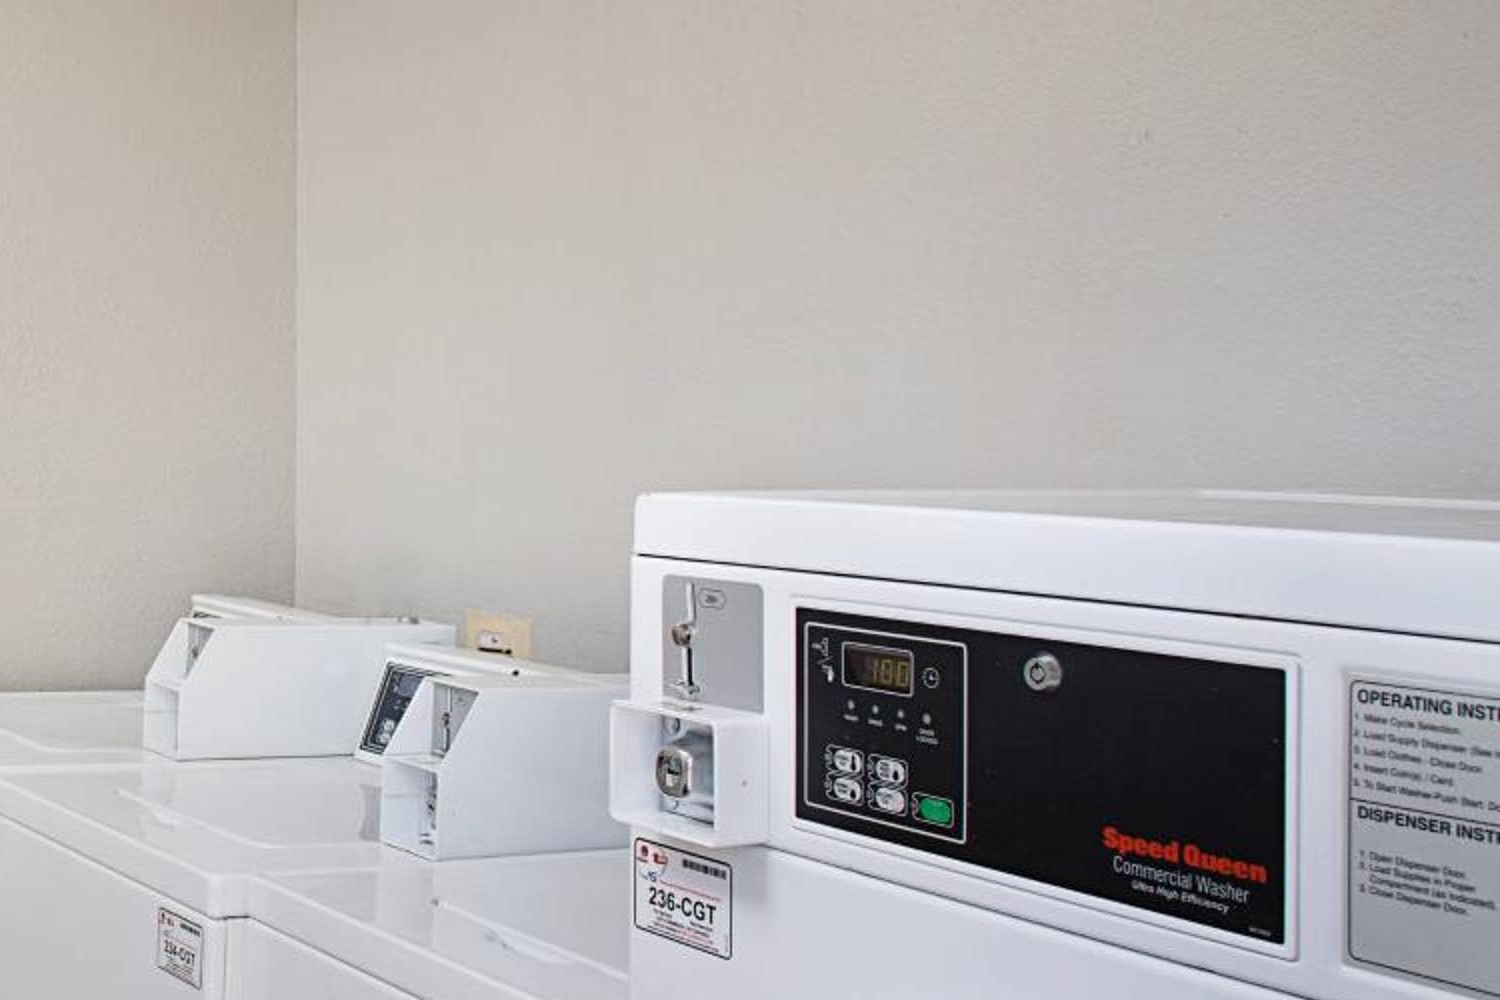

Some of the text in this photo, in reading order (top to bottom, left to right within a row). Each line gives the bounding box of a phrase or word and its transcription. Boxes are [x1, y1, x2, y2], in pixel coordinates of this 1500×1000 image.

[1357, 689, 1452, 715] OPERATING
[1357, 805, 1451, 836] DISPENSER
[1103, 825, 1268, 884] Speed Queen
[1112, 854, 1249, 903] Commercial Washer
[648, 886, 717, 925] 236-CGT
